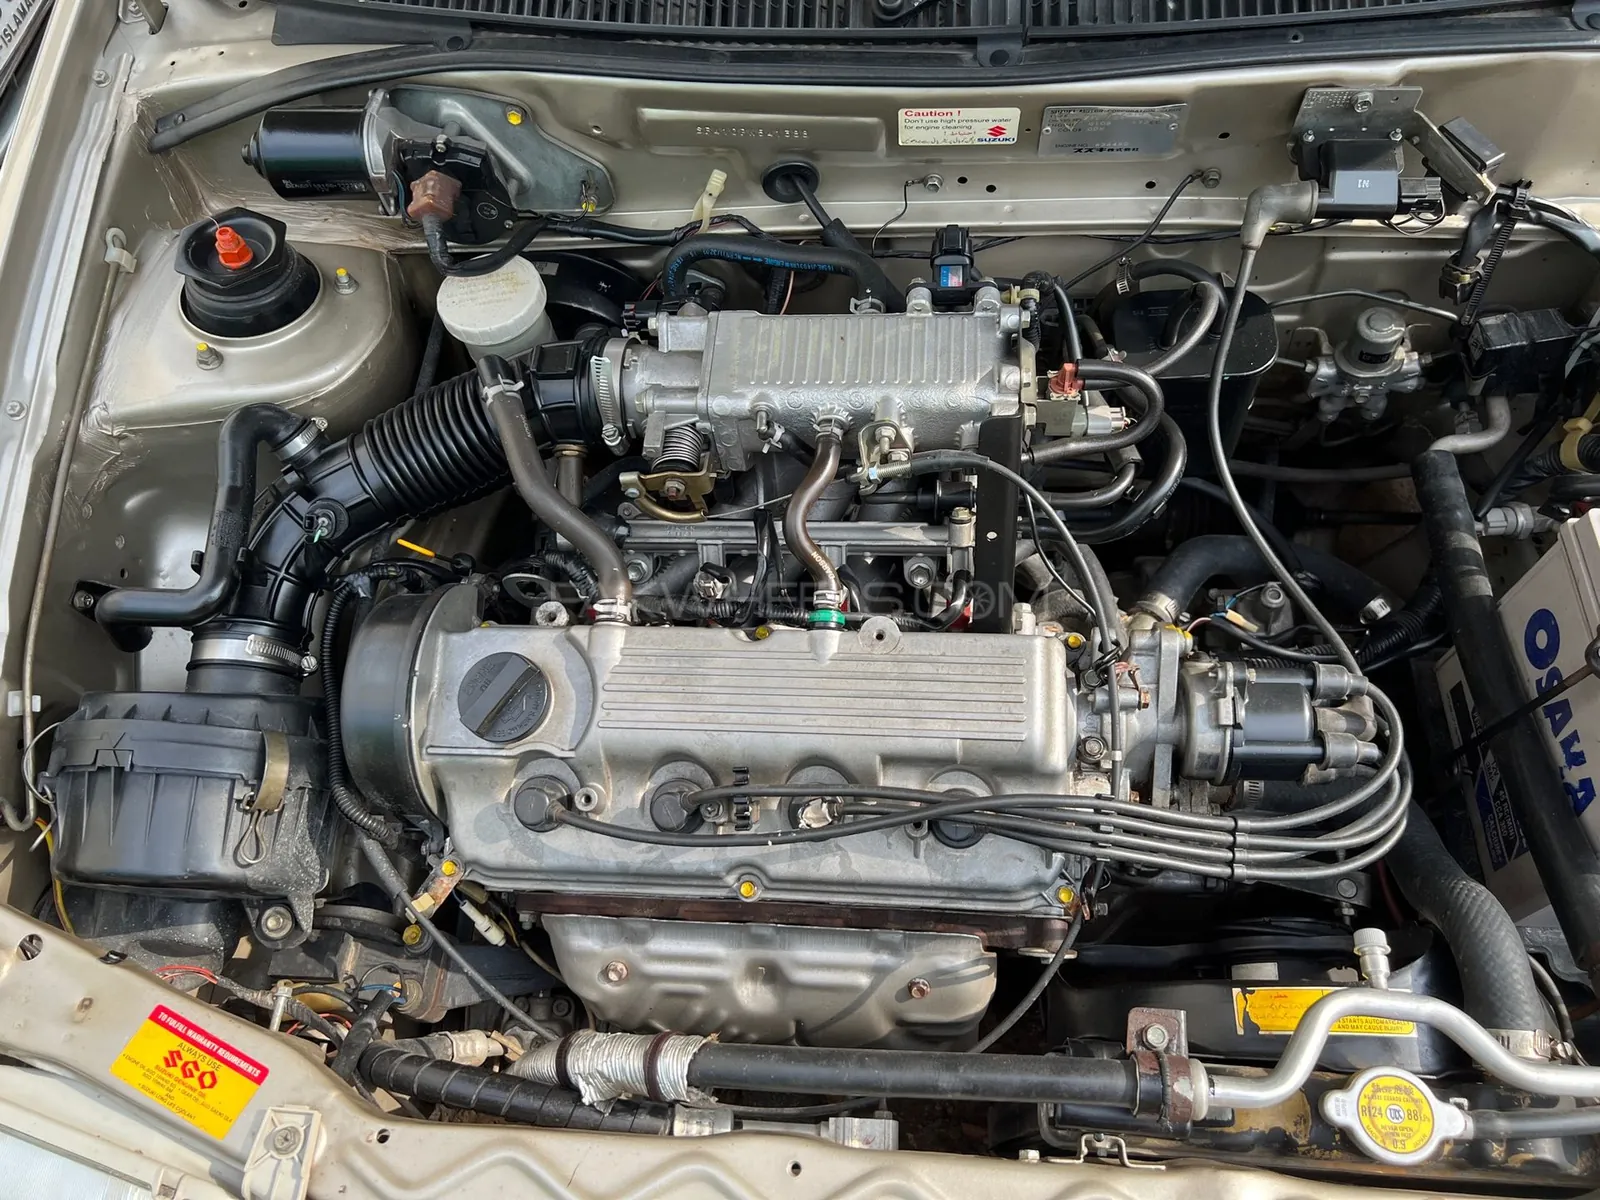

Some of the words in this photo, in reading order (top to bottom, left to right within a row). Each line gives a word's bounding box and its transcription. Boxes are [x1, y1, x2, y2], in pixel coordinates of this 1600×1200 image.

[159, 1012, 167, 1021] TO
[166, 1017, 187, 1033] FULFILL
[187, 1030, 218, 1050] WARRANTY
[218, 1048, 260, 1076] REQUIREMENTS
[177, 1042, 207, 1062] ALWAYS
[206, 1059, 221, 1071] USE
[164, 1050, 217, 1089] SGO
[1392, 1139, 1406, 1150] 0.9
